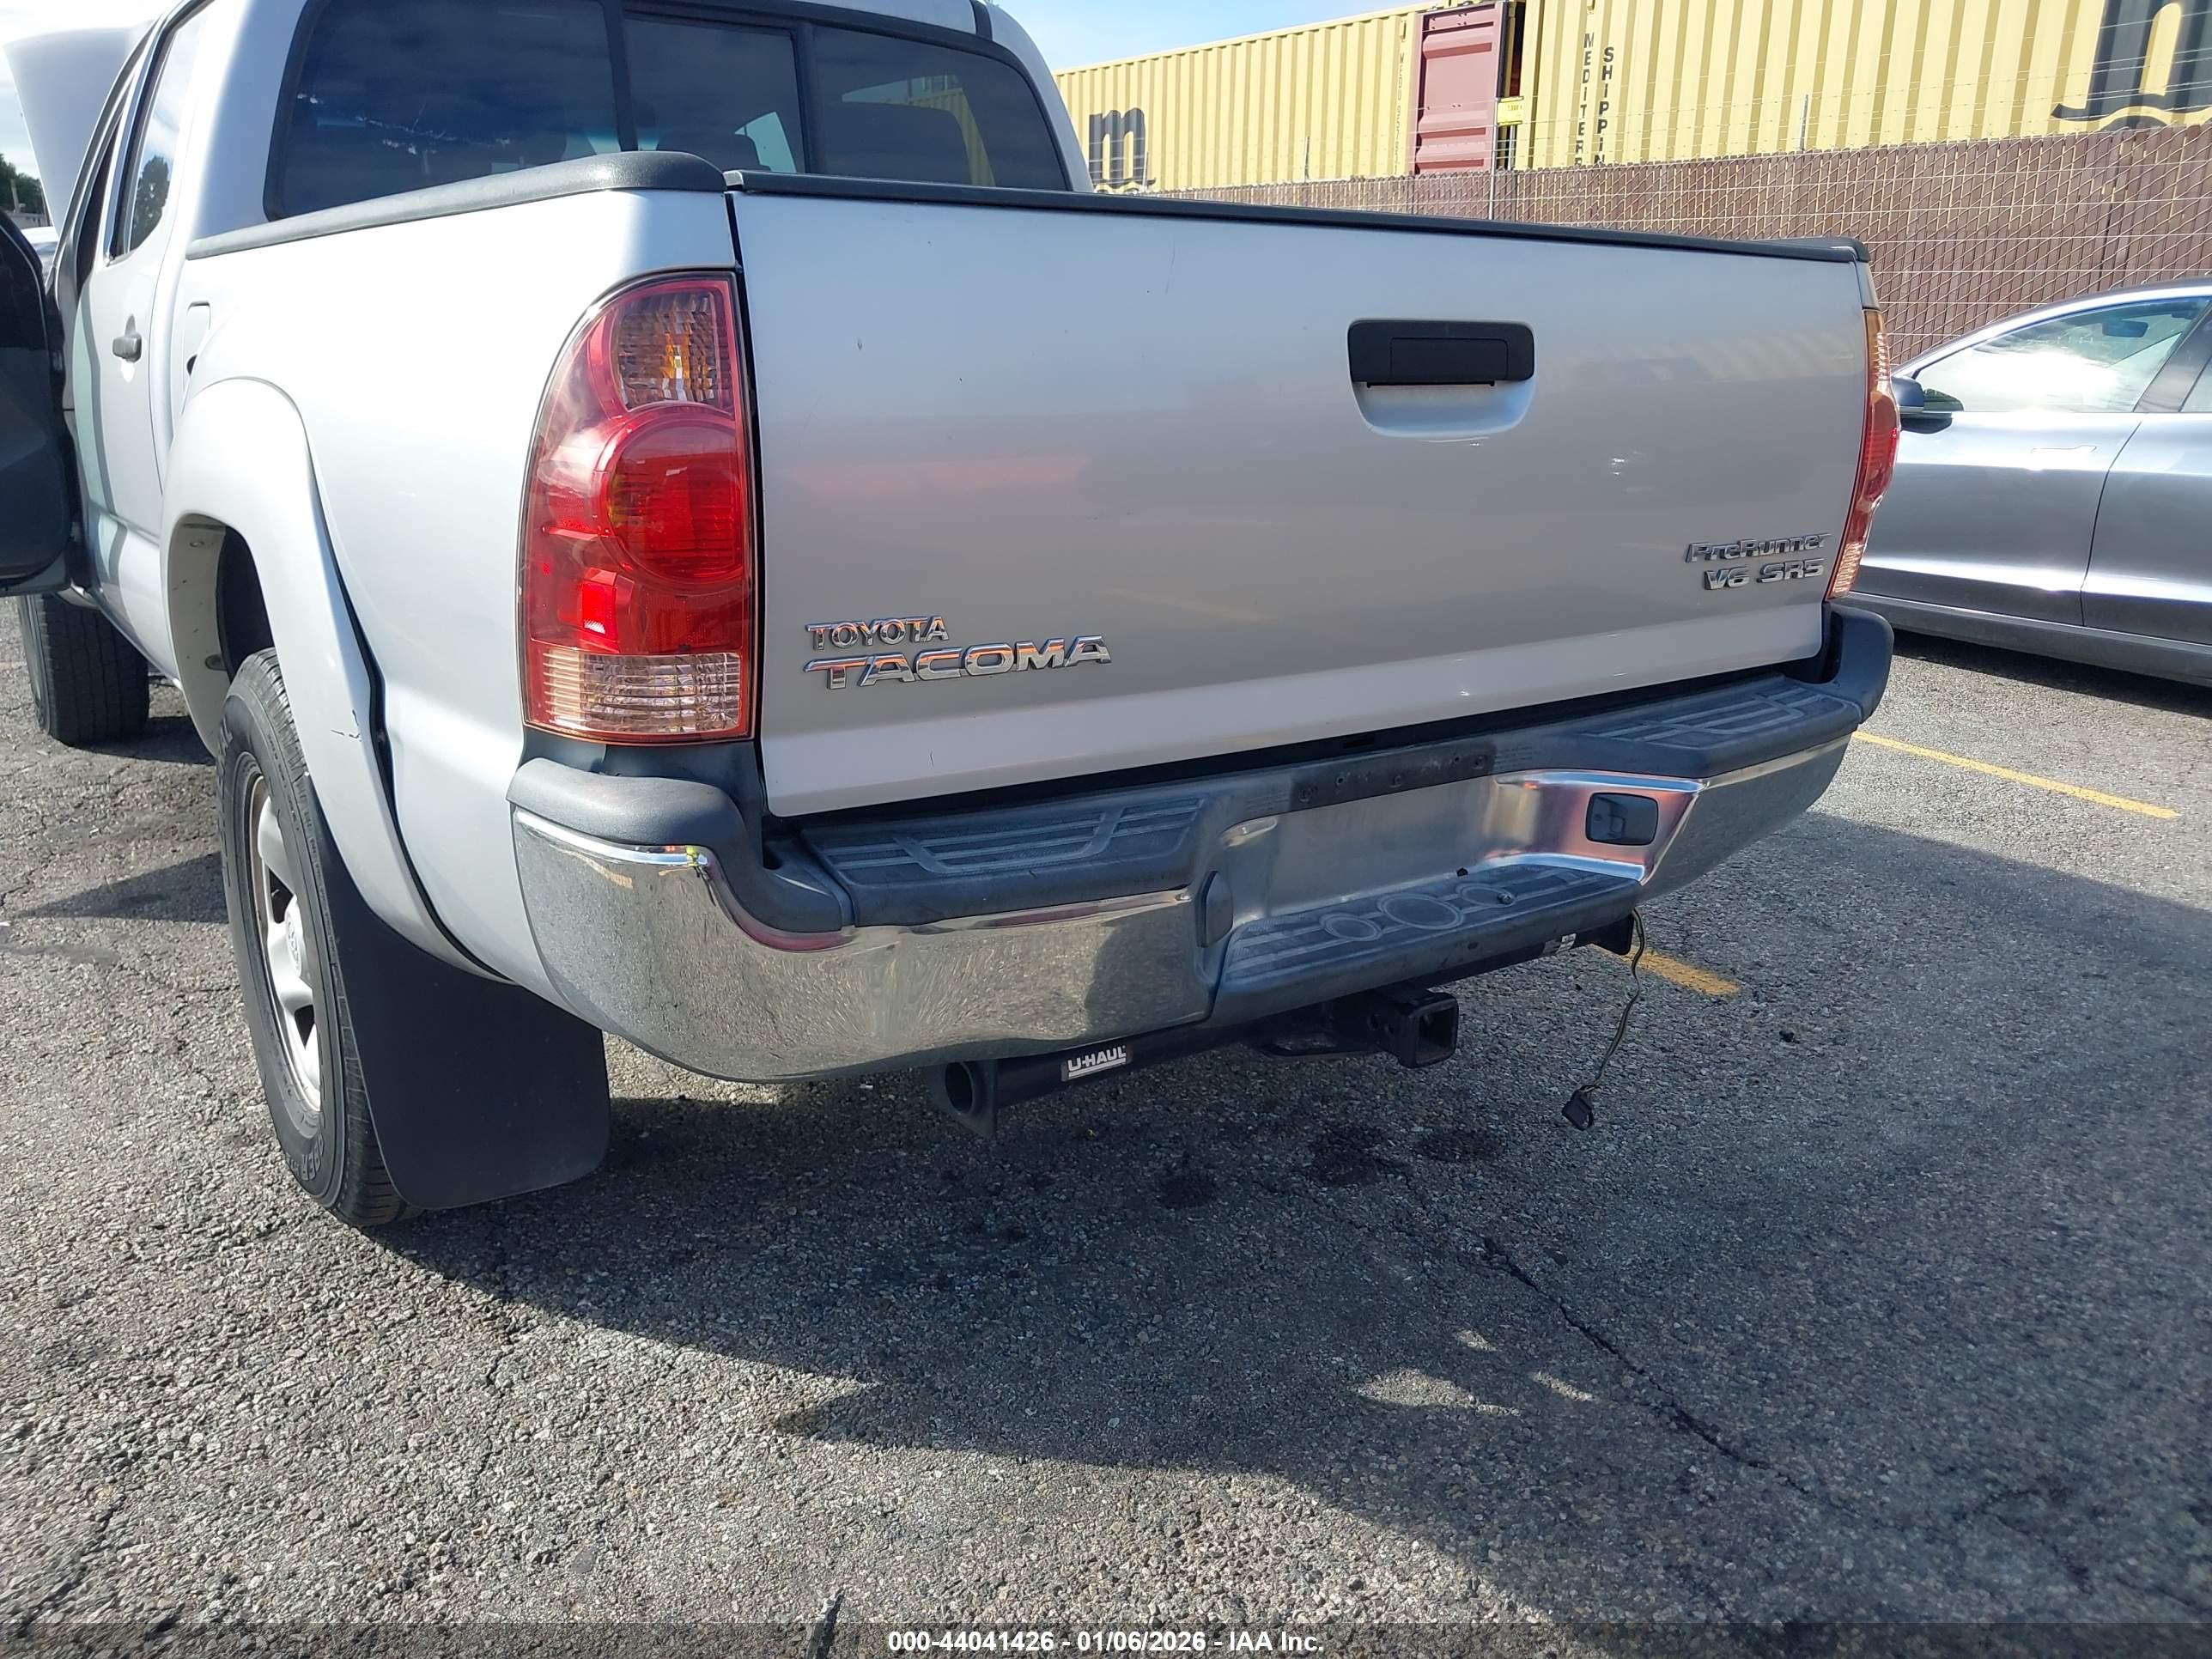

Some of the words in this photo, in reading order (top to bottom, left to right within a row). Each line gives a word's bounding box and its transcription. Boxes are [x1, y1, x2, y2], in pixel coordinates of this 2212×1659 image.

[1685, 532, 1832, 562] PreRunner
[1704, 566, 1751, 590] V6
[1756, 557, 1825, 583] SR5
[804, 616, 949, 650] TOYOTA
[803, 634, 1112, 690] TACOMA
